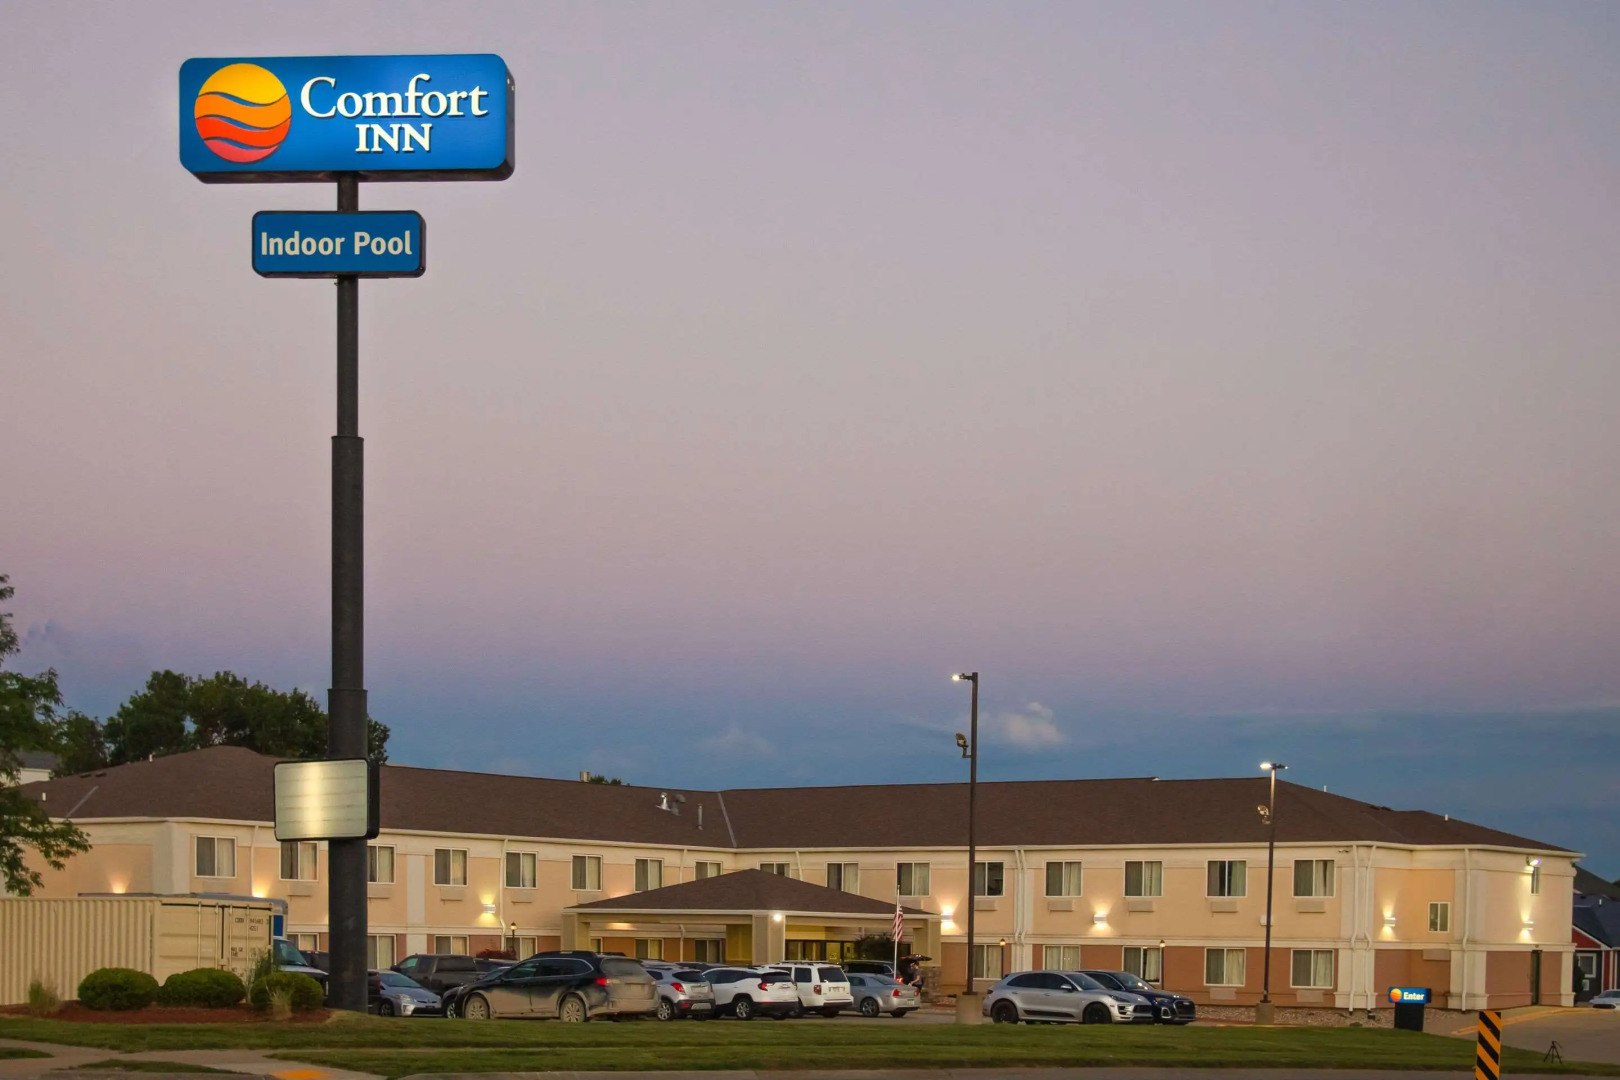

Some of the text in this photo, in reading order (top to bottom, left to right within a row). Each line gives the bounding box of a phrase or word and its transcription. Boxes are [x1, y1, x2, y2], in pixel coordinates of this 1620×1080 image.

[300, 73, 488, 117] Comfort
[355, 123, 433, 152] INN
[261, 230, 412, 255] Indoor Pool
[1403, 991, 1424, 1000] Enter
